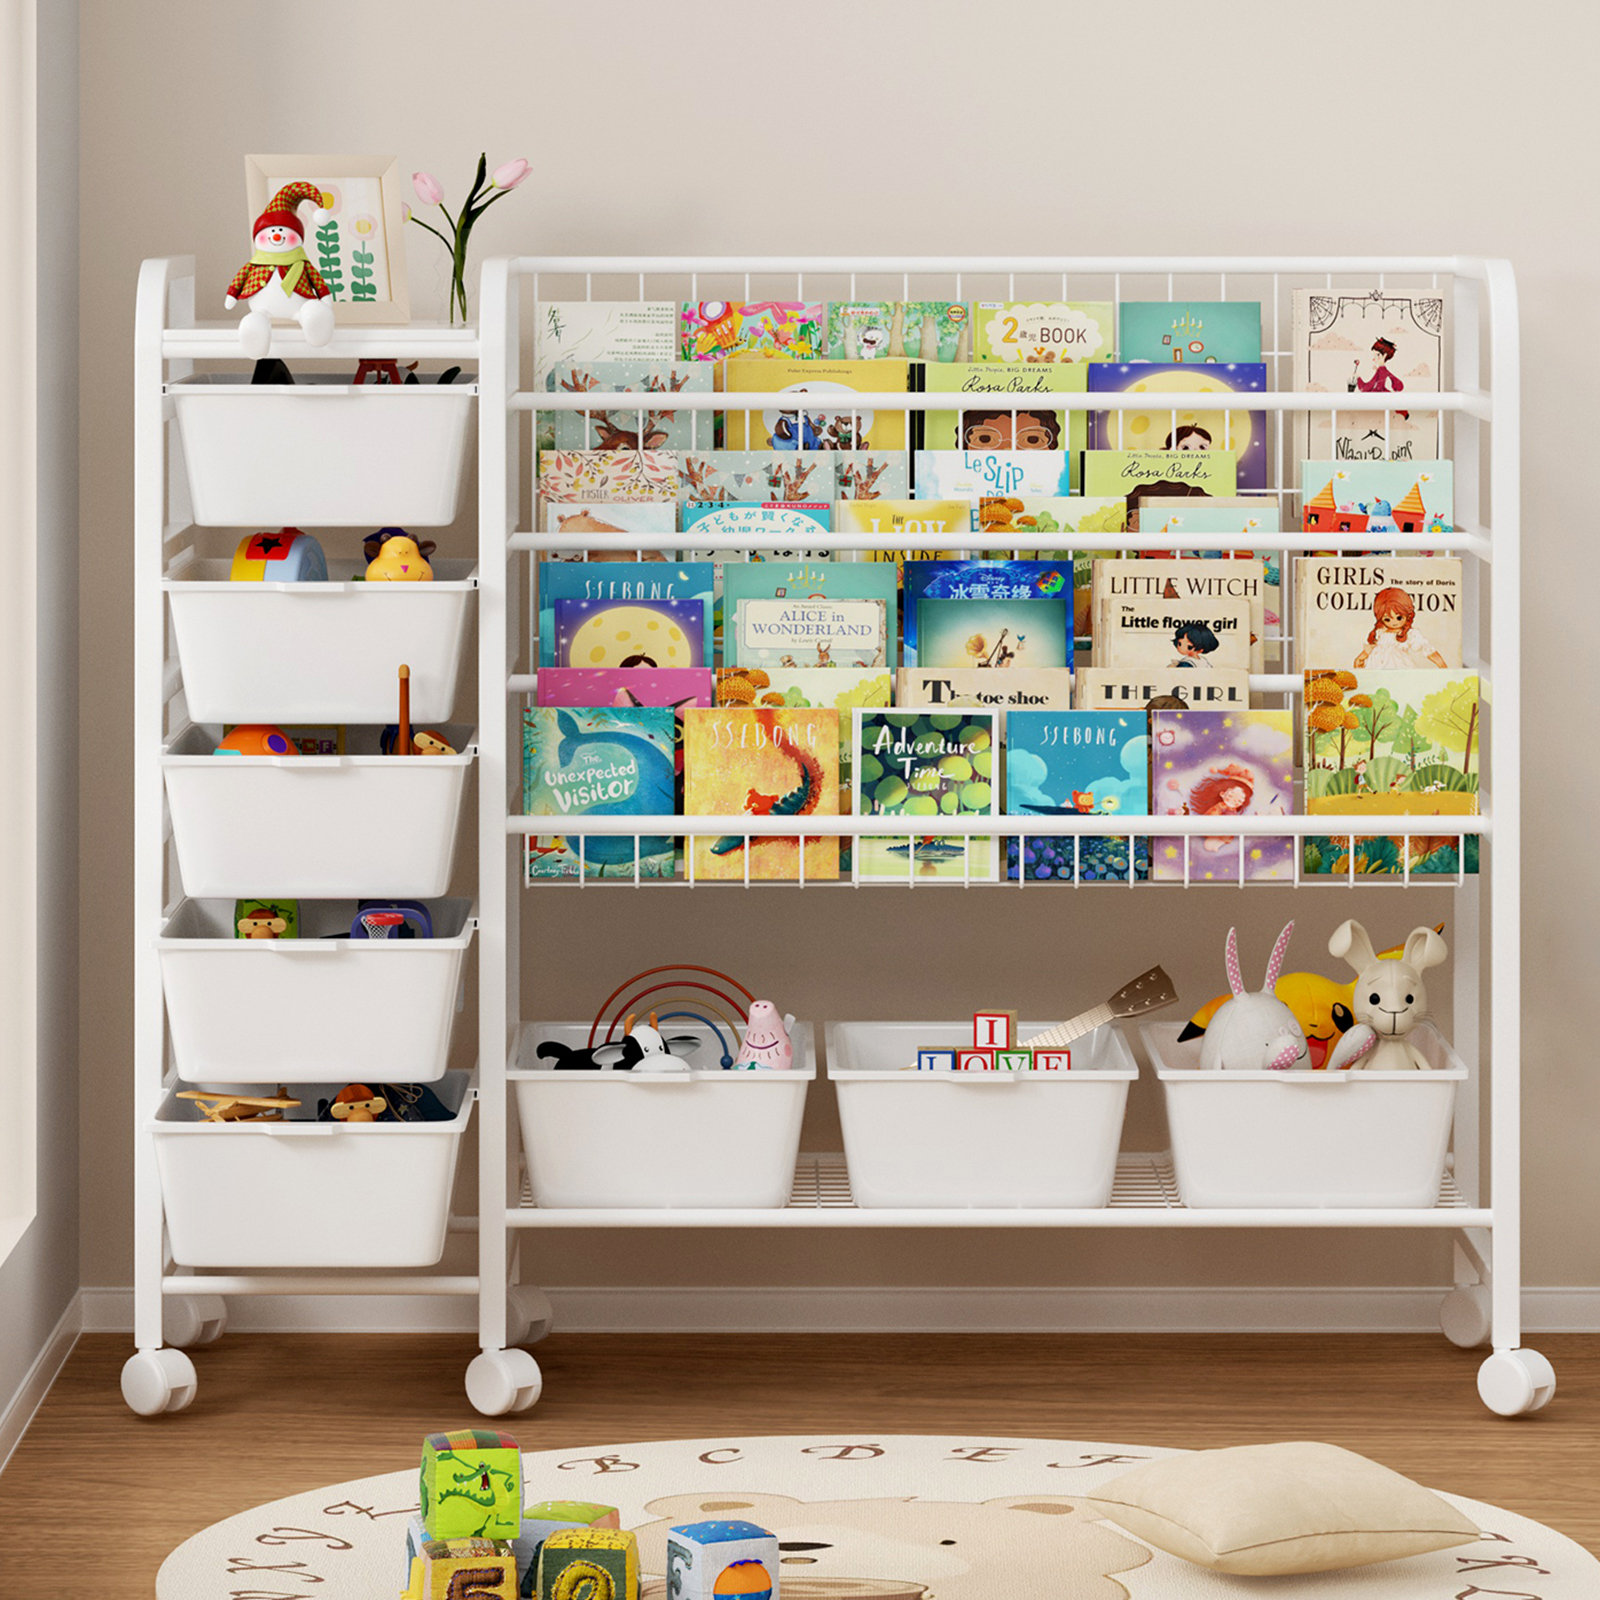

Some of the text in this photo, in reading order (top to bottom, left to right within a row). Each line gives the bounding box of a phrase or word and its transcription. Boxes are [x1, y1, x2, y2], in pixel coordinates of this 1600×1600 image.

[1040, 327, 1087, 343] BOOK
[961, 375, 1053, 393] Rosa Parks
[965, 452, 982, 473] Le
[1121, 461, 1212, 479] Rosa Parks
[1317, 566, 1385, 586] GIRLS
[1405, 579, 1423, 587] story
[949, 584, 1032, 599] 冰雪奇缘
[1187, 578, 1258, 596] WITCH
[1317, 592, 1457, 612] COLLION
[780, 611, 845, 622] ALICE in
[1121, 616, 1159, 628] Little
[1213, 618, 1238, 632] girl
[752, 623, 872, 636] WONDERLAND
[976, 691, 1004, 704] toe
[1008, 691, 1049, 705] shoe
[1101, 685, 1243, 702] THE GIRL
[872, 724, 981, 755] Adventure
[1040, 725, 1116, 746] SSEBONG
[897, 757, 955, 779] Time
[985, 1019, 998, 1045] I
[698, 1448, 744, 1465] C
[801, 1444, 885, 1461] D
[943, 1447, 1024, 1463] E
